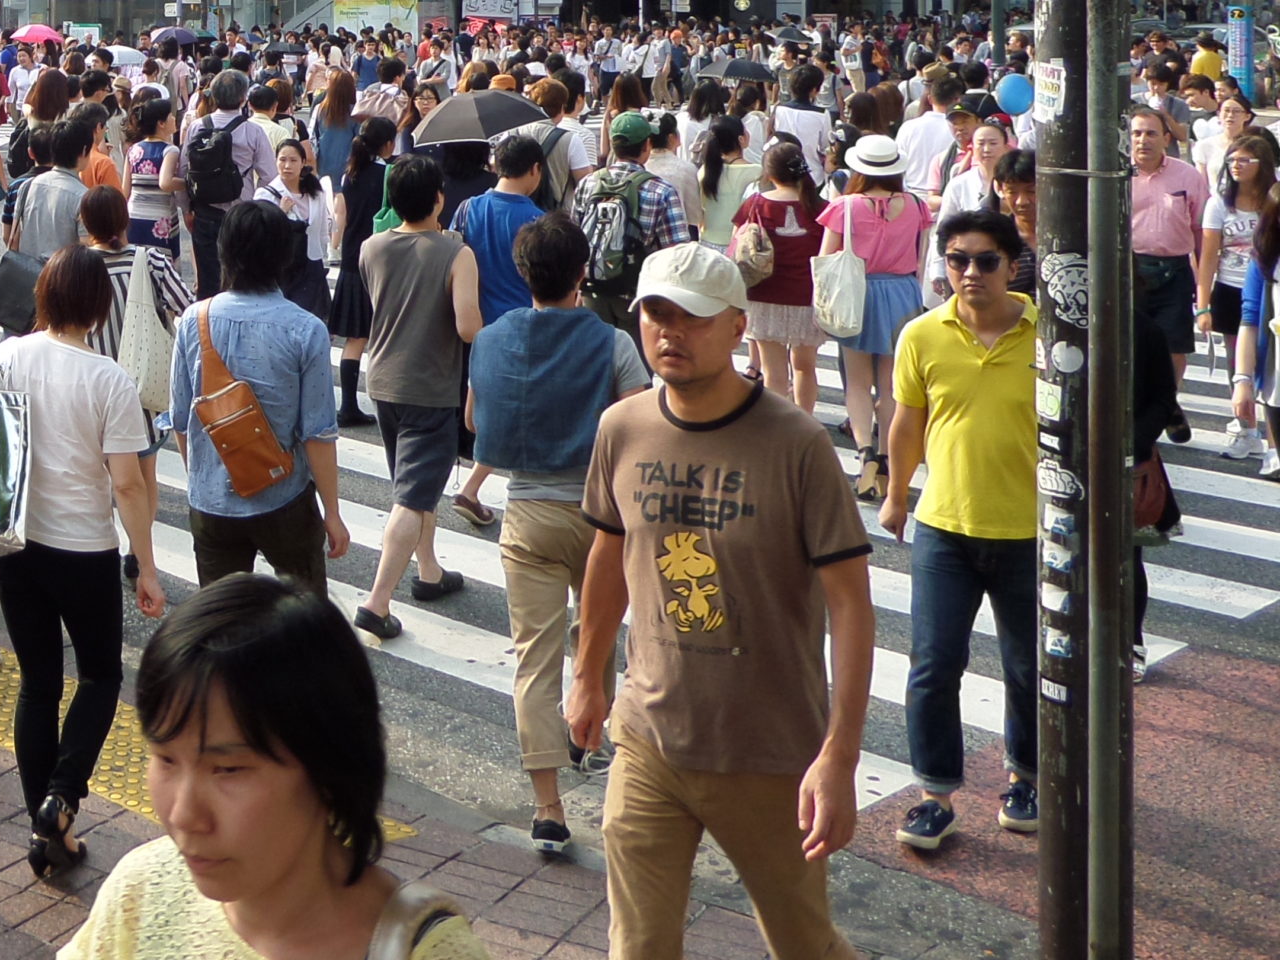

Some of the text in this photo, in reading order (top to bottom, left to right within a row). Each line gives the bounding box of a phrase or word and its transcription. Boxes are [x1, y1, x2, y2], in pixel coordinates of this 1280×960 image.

[635, 460, 746, 494] TALK IS
[633, 490, 757, 531] "CHEEP"
